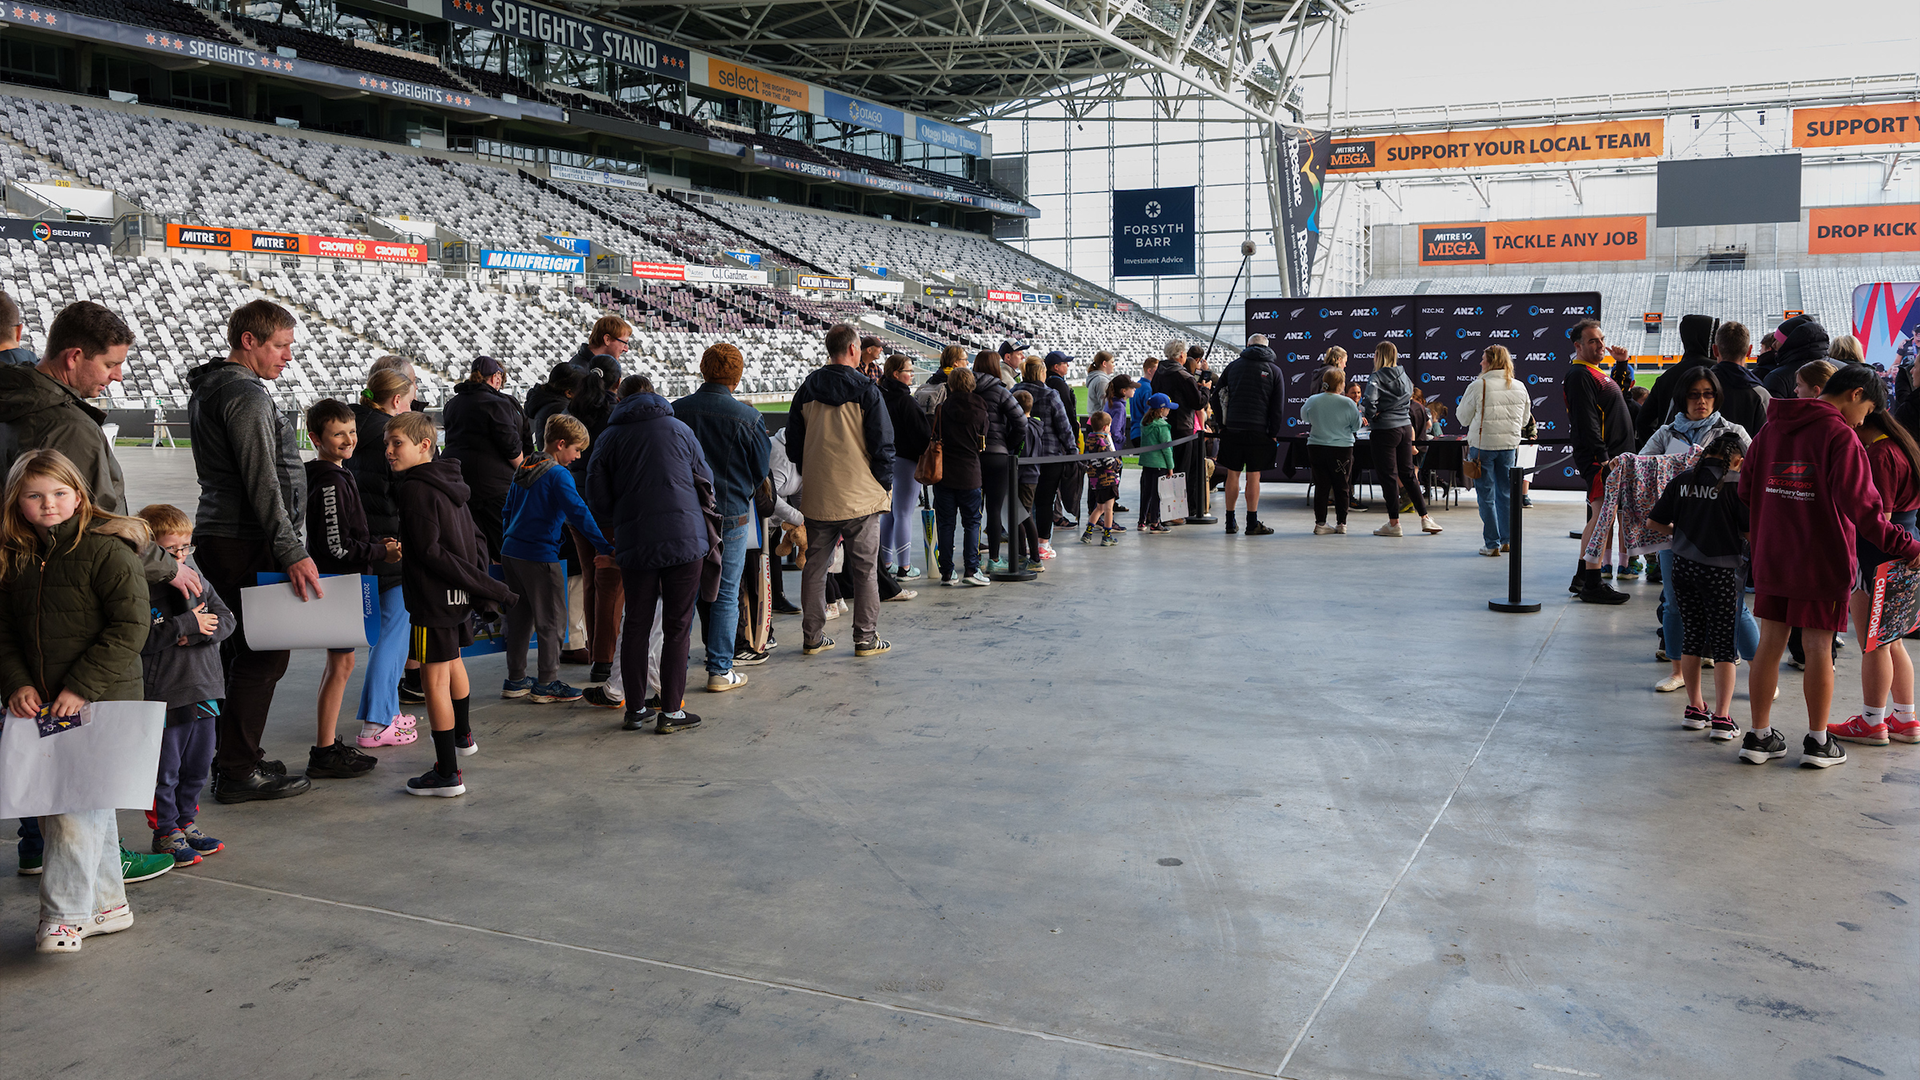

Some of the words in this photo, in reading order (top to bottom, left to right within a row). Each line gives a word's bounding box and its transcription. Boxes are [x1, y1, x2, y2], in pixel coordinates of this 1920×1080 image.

[491, 0, 594, 51] SPEIGHT'S
[602, 31, 658, 68] STAND
[189, 40, 256, 66] SPEIGHT'S
[718, 67, 759, 94] select
[391, 81, 443, 102] SPEIGHT'S
[772, 84, 784, 93] RIGHT
[786, 87, 802, 98] PEOPLE
[772, 92, 781, 100] THE
[860, 108, 882, 123] OTAGO
[1807, 116, 1909, 137] SUPPORT
[922, 125, 941, 142] Otago
[942, 130, 958, 147] Daily
[959, 135, 977, 150] Times
[1335, 146, 1356, 154] MITRE
[1387, 143, 1470, 161] SUPPORT
[1474, 140, 1525, 157] YOUR
[1529, 136, 1591, 153] LOCAL
[1596, 132, 1651, 149] TEAM
[1330, 153, 1371, 166] MEGA
[552, 165, 583, 174] INTERNATIONAL
[559, 172, 579, 180] LOGISTICS
[801, 163, 826, 176] SPEIGHT'S
[1288, 136, 1302, 207] Resene
[879, 179, 900, 190] SPEIGHT'S
[944, 192, 962, 202] SPEIGHT'S
[1124, 223, 1184, 235] FORSYTH
[1818, 224, 1869, 239] DROP
[1874, 222, 1917, 237] KICK
[181, 231, 214, 243] MITRE
[216, 234, 229, 244] 10
[254, 237, 284, 248] MITRE
[285, 239, 297, 249] 10
[1136, 237, 1171, 248] BARR
[1434, 233, 1460, 241] MITRE
[1461, 232, 1472, 240] 10
[1493, 235, 1556, 250] TACKLE
[1559, 233, 1598, 247] ANY
[1602, 232, 1638, 246] JOB
[319, 241, 354, 252] CROWN
[375, 246, 407, 256] CROWN
[1428, 242, 1480, 256] MEGA
[488, 253, 579, 271] MAINFREIGHT
[1161, 256, 1183, 264] Advice
[1297, 228, 1308, 295] Resene
[712, 268, 723, 280] G.J.
[831, 280, 848, 288] trucks
[990, 292, 1004, 300] RICOH
[1284, 332, 1303, 340] ANZ
[1489, 330, 1510, 338] ANZ
[1418, 352, 1438, 360] ANZ
[1680, 484, 1718, 499] WANG
[322, 485, 348, 560] NORTHERN
[363, 582, 372, 615] 2024/2025
[1869, 578, 1885, 638] CHAMPIONS
[154, 617, 164, 625] NZ
